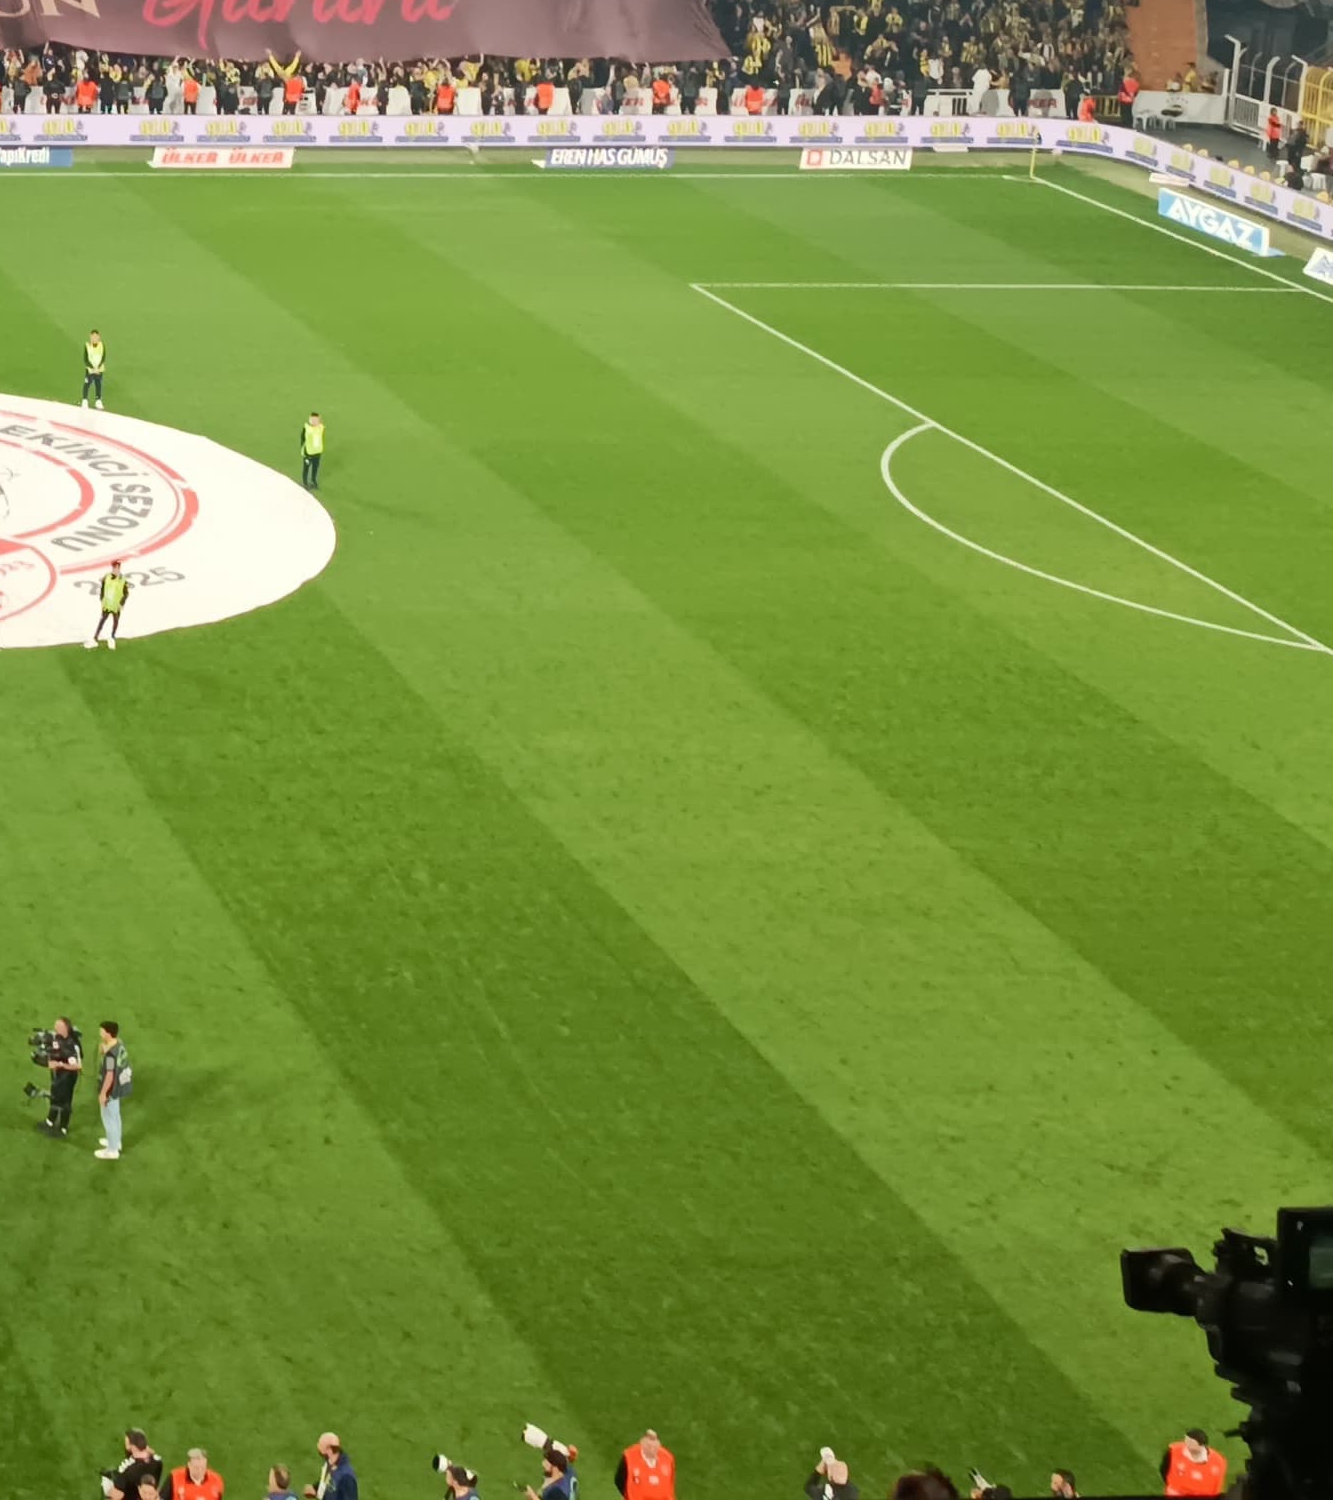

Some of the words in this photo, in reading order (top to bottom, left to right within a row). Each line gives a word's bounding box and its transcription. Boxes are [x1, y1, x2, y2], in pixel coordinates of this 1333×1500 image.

[161, 147, 218, 164] ÜLKER
[228, 148, 284, 165] ÜLKER
[551, 149, 585, 165] EREN
[587, 149, 616, 165] HAS
[829, 150, 907, 166] DALSAN
[1165, 197, 1256, 249] AYGAZ
[50, 483, 155, 553] SEZONU
[74, 565, 186, 596] 225
